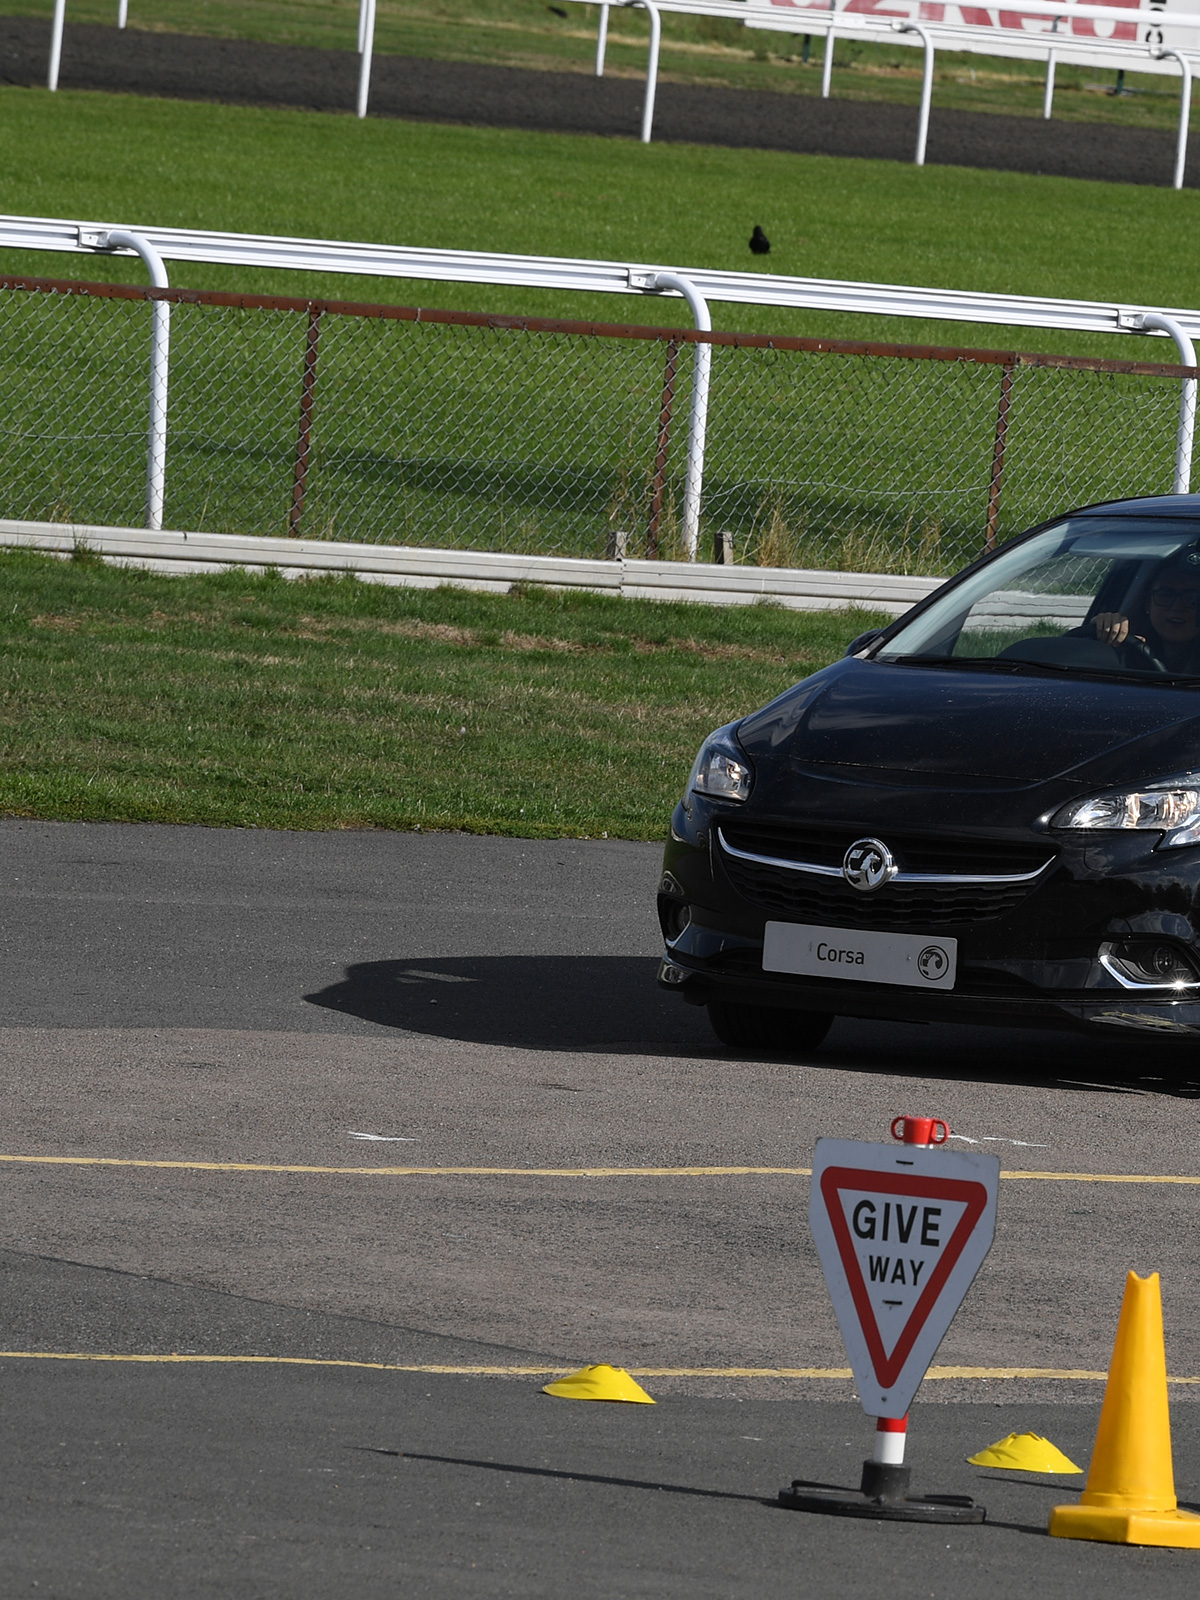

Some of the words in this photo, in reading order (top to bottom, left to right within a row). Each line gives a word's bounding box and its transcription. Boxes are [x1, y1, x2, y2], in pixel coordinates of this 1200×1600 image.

[816, 942, 865, 965] Corsa
[852, 1199, 942, 1247] GIVE
[868, 1254, 925, 1287] WAY
